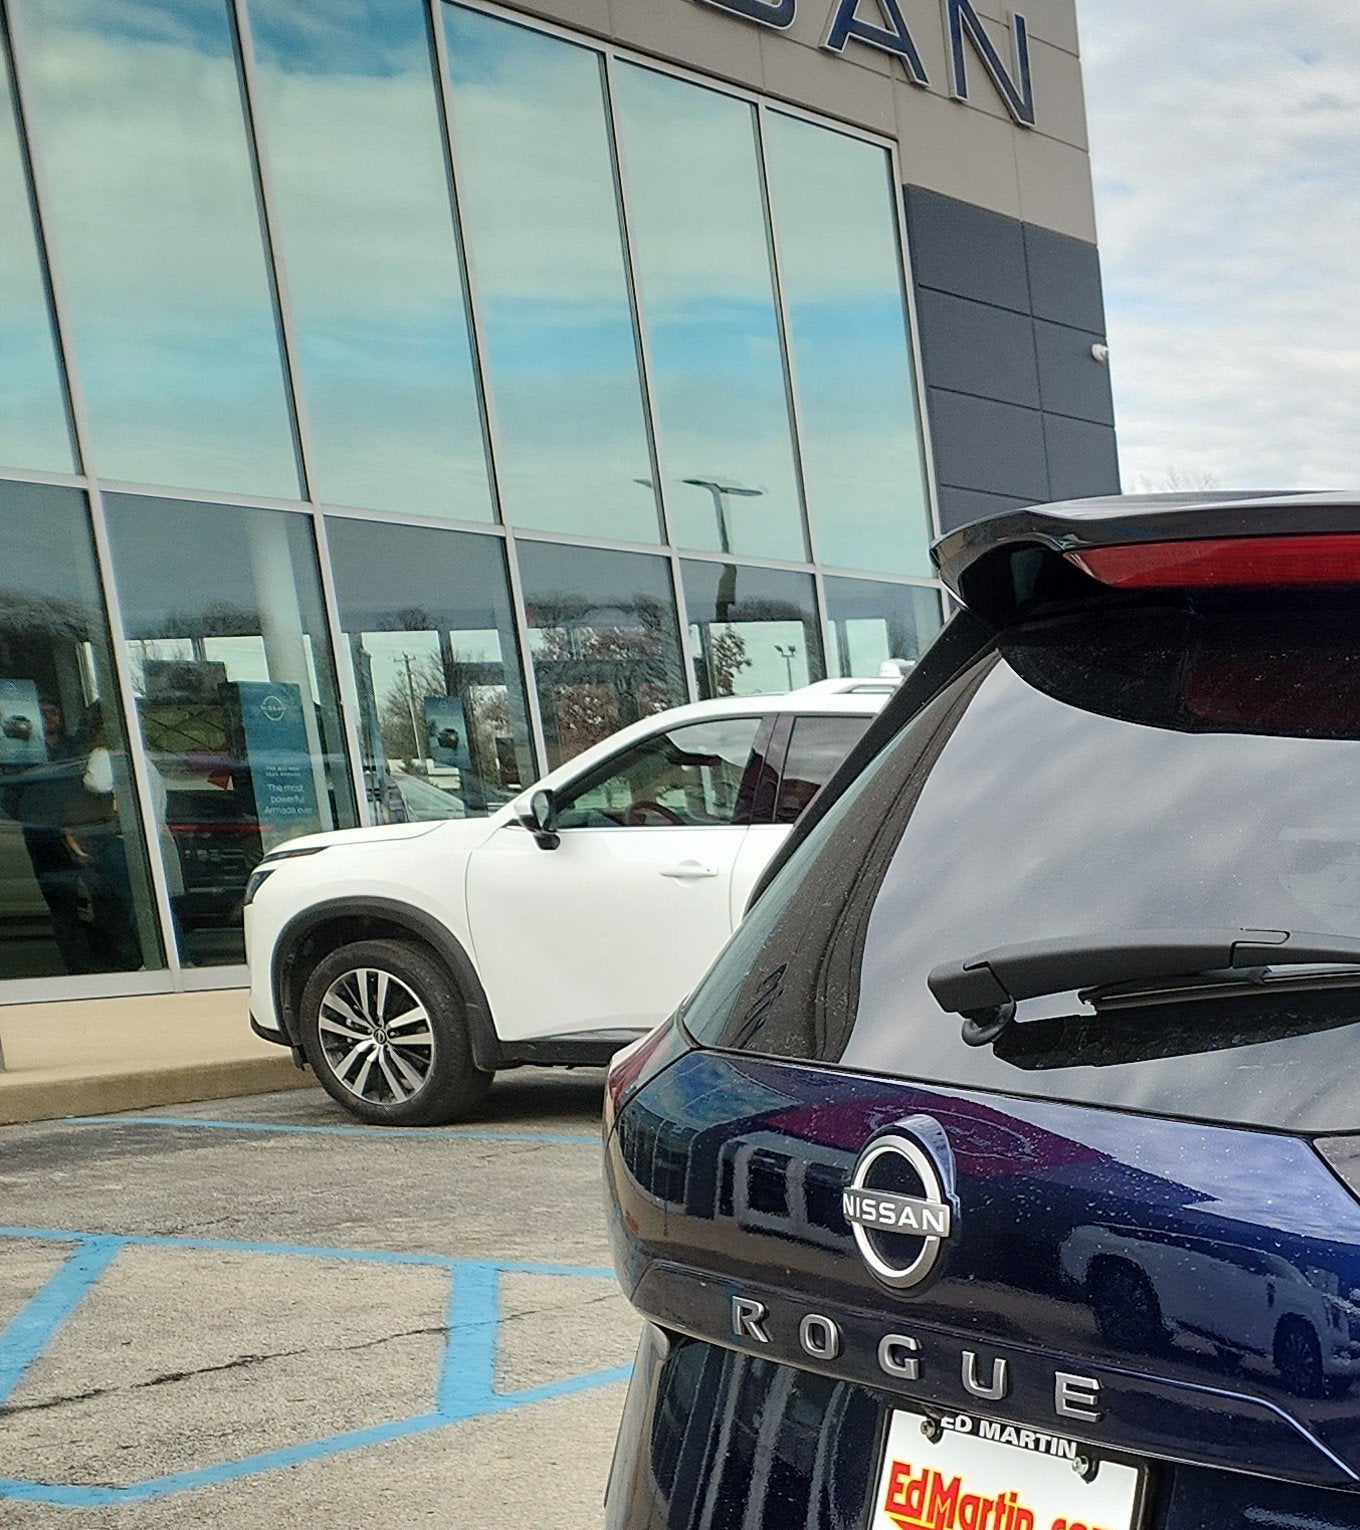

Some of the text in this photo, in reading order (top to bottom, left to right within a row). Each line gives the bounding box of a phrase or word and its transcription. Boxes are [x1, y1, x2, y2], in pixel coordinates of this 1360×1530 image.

[842, 1193, 944, 1233] NISSAN
[731, 1295, 1103, 1423] ROGUE
[979, 1419, 1078, 1459] MARTIN
